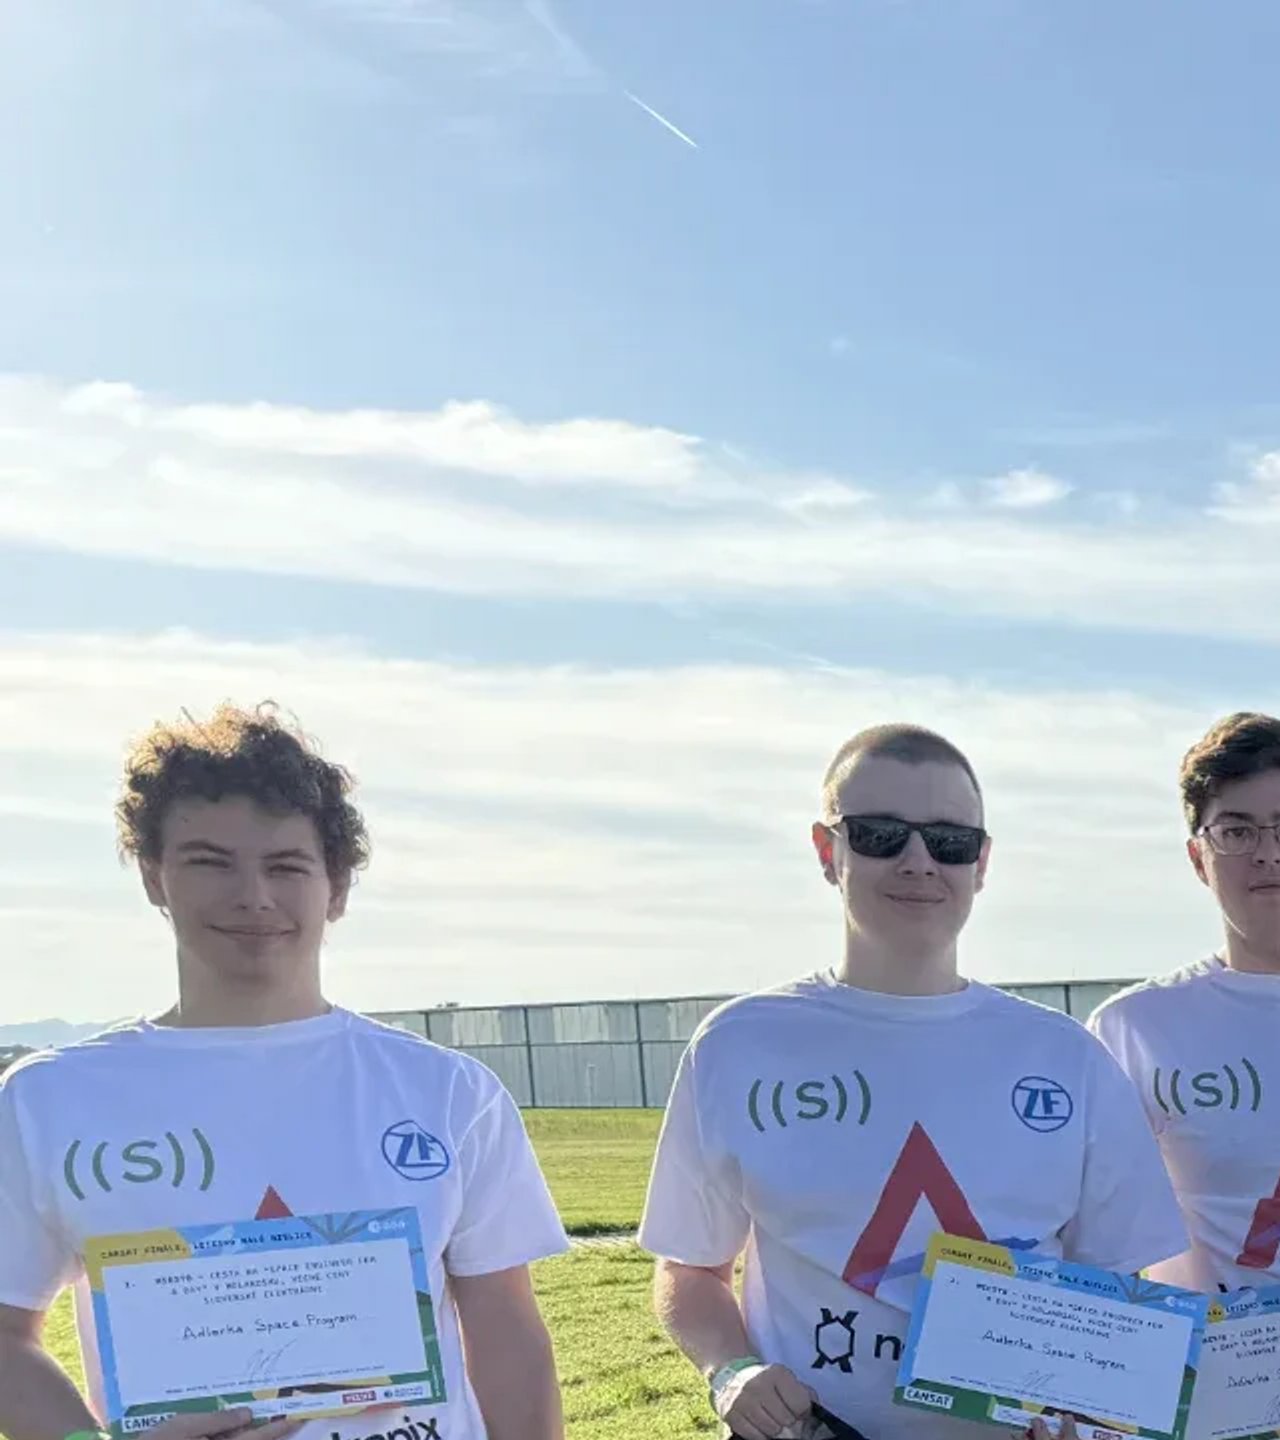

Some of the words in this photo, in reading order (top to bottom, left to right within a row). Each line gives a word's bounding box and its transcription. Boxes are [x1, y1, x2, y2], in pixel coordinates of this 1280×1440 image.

[1013, 1083, 1071, 1121] ZF
[386, 1129, 448, 1168] ZF
[255, 1318, 300, 1335] Space
[306, 1313, 358, 1330] Program
[906, 1388, 950, 1406] CANSAT
